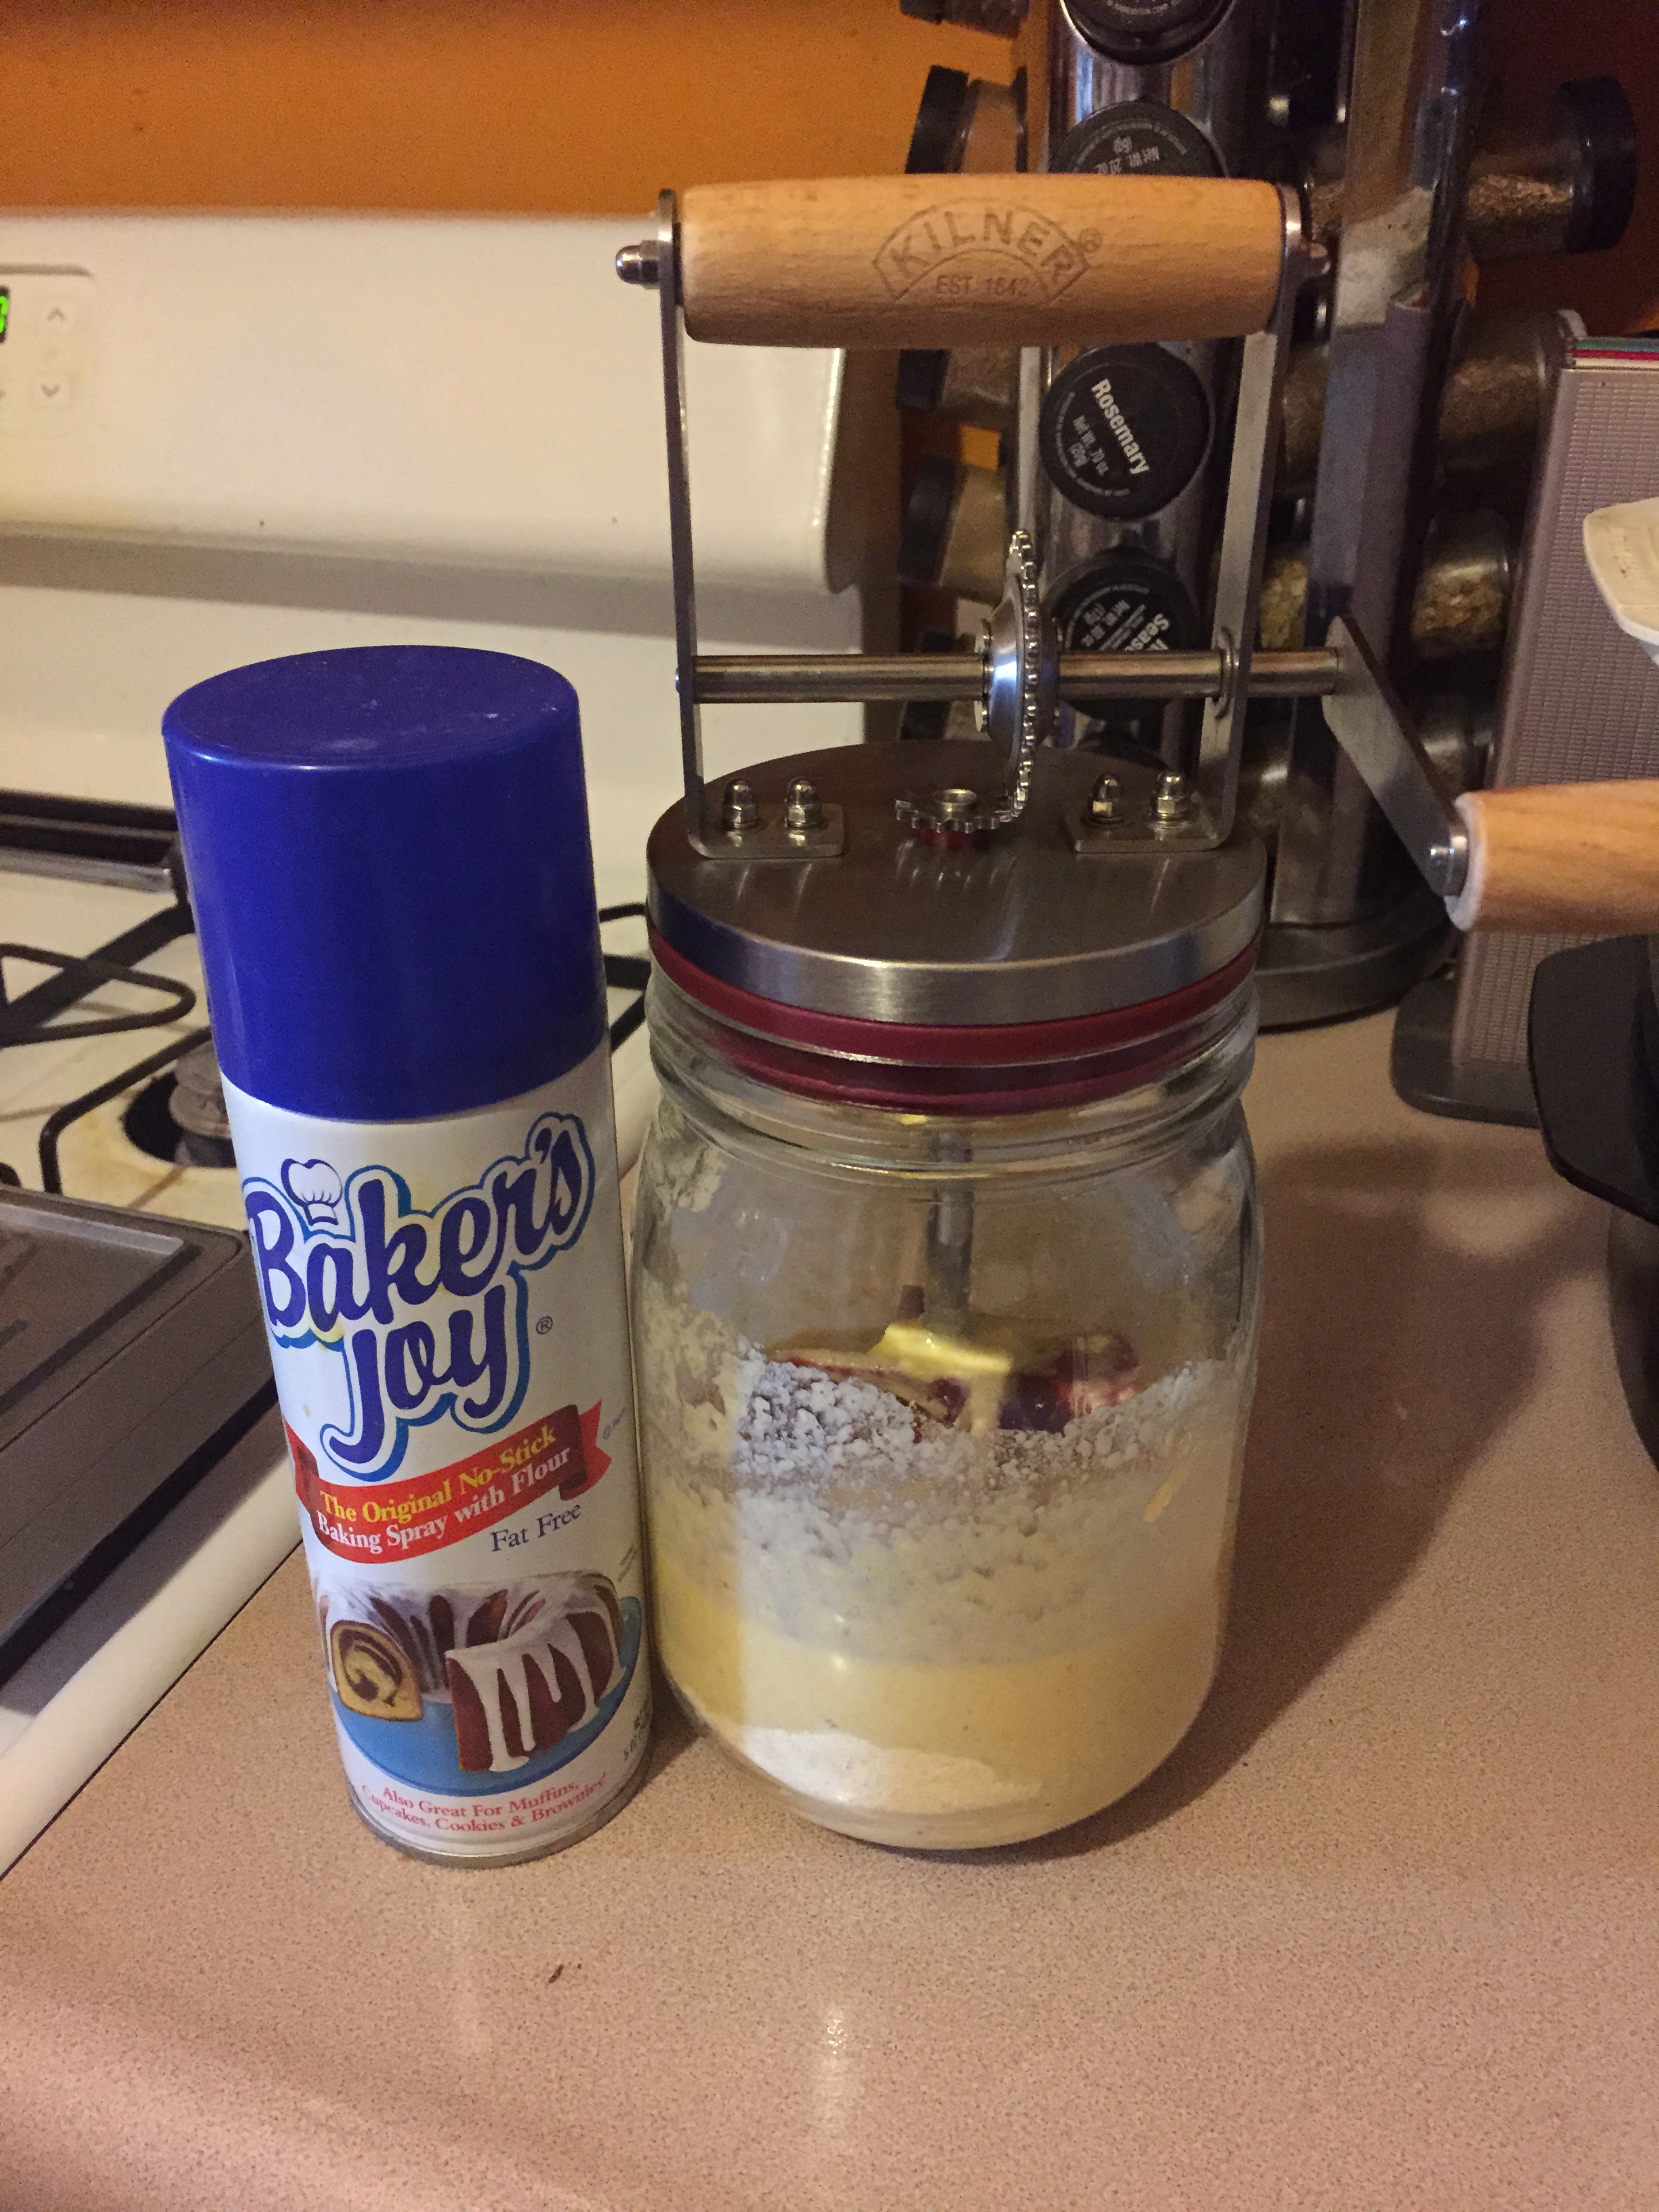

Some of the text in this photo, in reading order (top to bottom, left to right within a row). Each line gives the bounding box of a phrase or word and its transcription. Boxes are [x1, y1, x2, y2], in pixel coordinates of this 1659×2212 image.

[889, 209, 1076, 284] KILNER
[936, 274, 973, 294] EST
[1090, 378, 1150, 474] Rosemary
[245, 1128, 581, 1332] Baker's
[329, 1284, 508, 1464] Joy
[316, 1447, 571, 1554] Baking Spray with Flour
[320, 1425, 556, 1524] The Original No-Stick
[490, 1504, 581, 1552] Fat Free
[383, 1786, 414, 1809] Also
[418, 1799, 467, 1818] Great
[472, 1804, 503, 1817] For
[435, 1818, 506, 1832] Cookies
[510, 1816, 525, 1827] &
